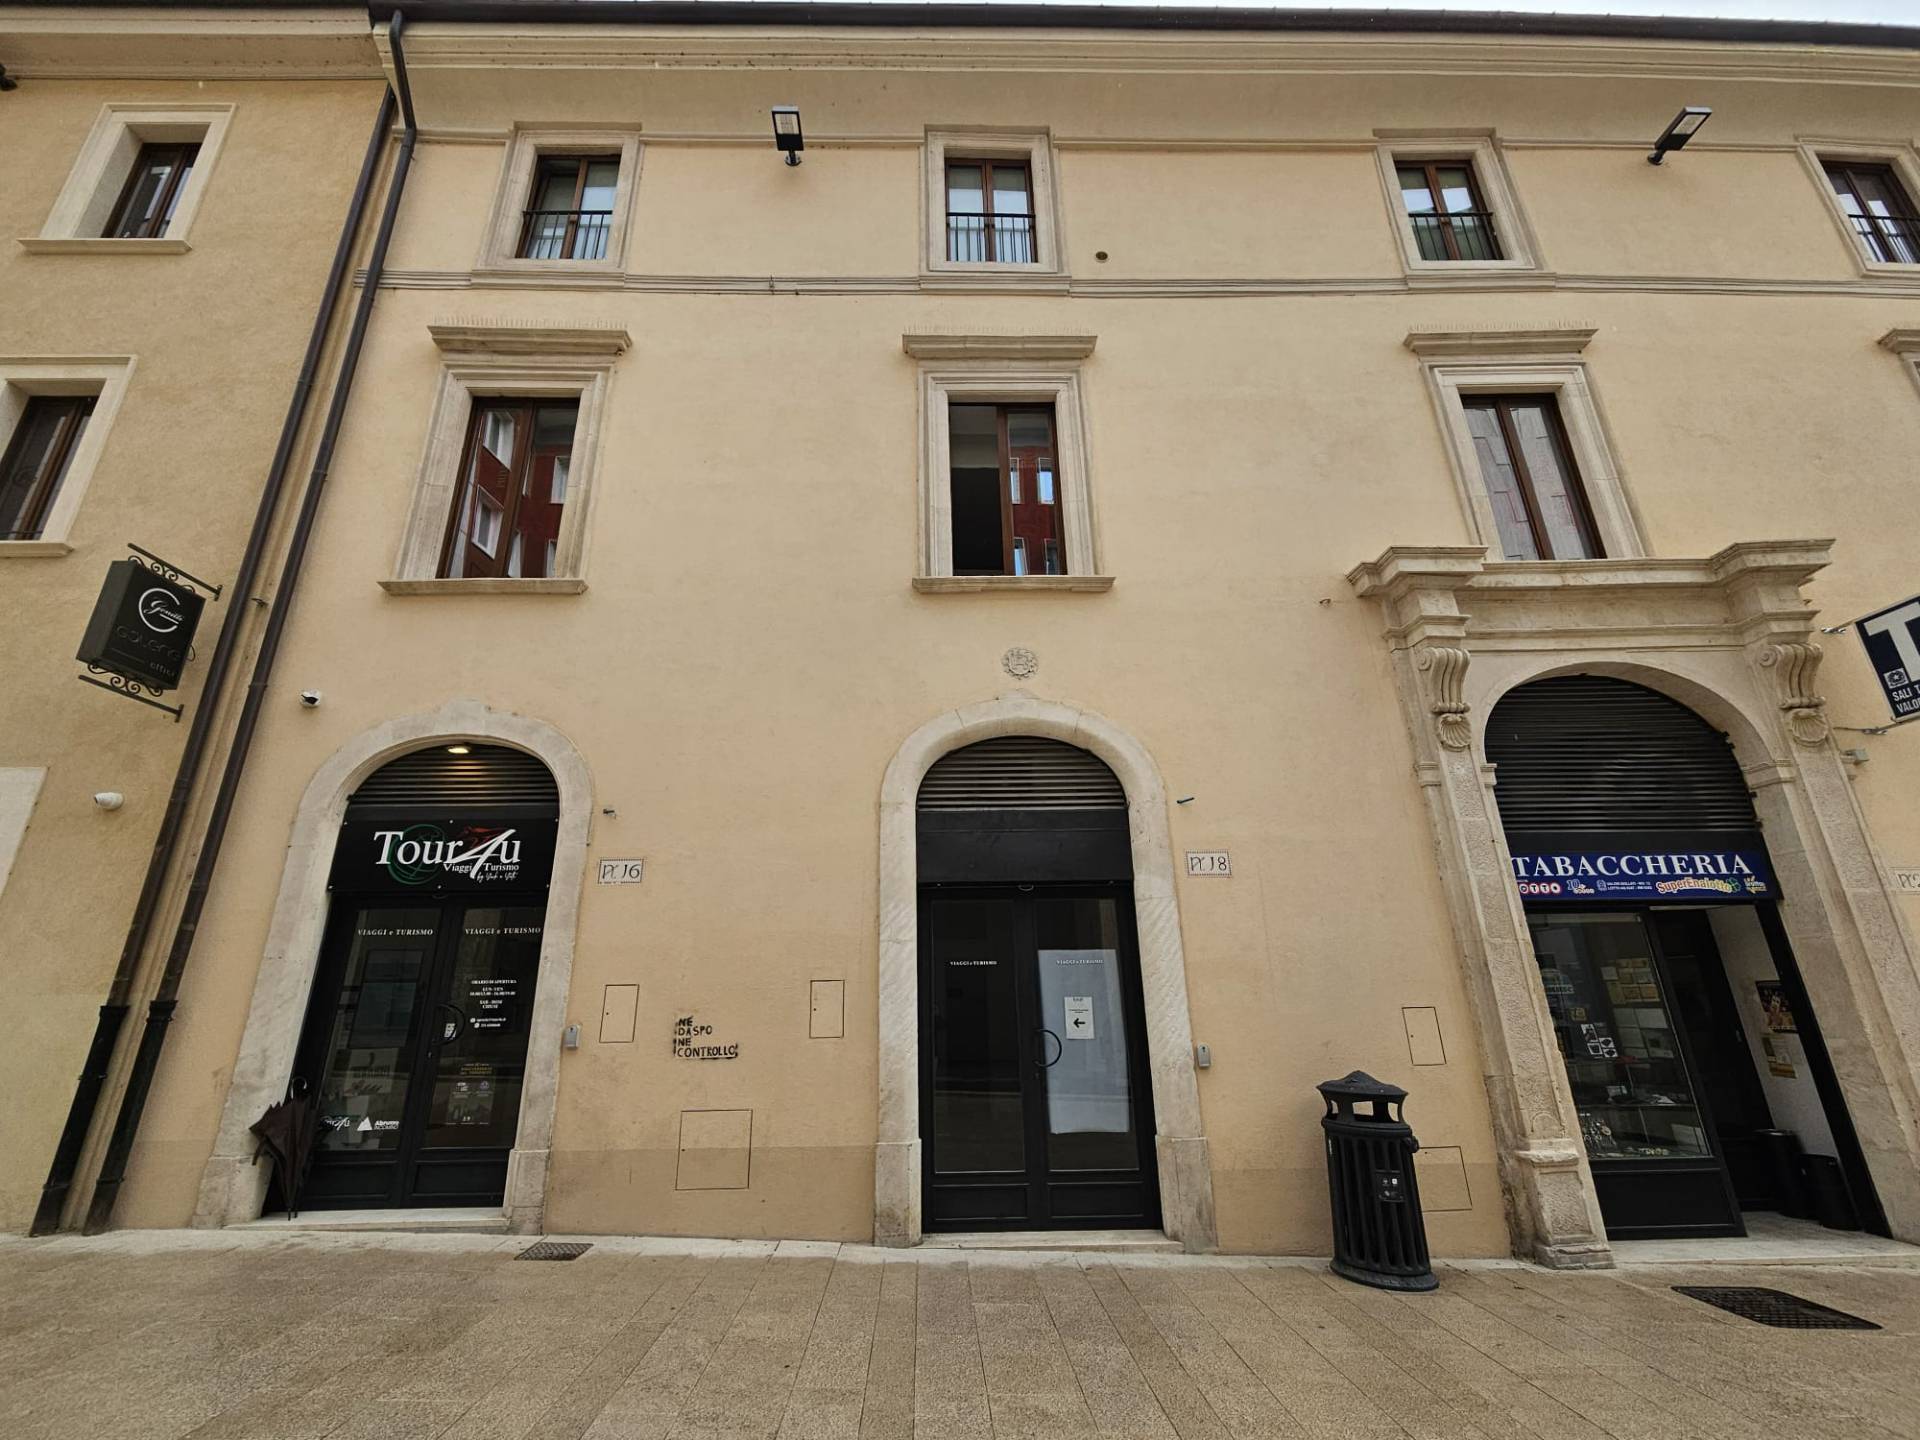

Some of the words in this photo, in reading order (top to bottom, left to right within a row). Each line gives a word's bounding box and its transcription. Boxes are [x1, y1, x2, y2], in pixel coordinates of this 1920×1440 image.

[1892, 688, 1913, 701] SALI
[443, 862, 473, 874] Viaggi
[483, 862, 520, 872] Turismo
[1511, 854, 1753, 876] TABACCHERIA
[1519, 883, 1561, 894] OTTO
[357, 928, 387, 936] VIAGGI
[396, 928, 434, 936] TURISMO
[465, 927, 495, 936] VIAGGI
[503, 926, 541, 935] TURISMO
[677, 1025, 713, 1036] DASPO
